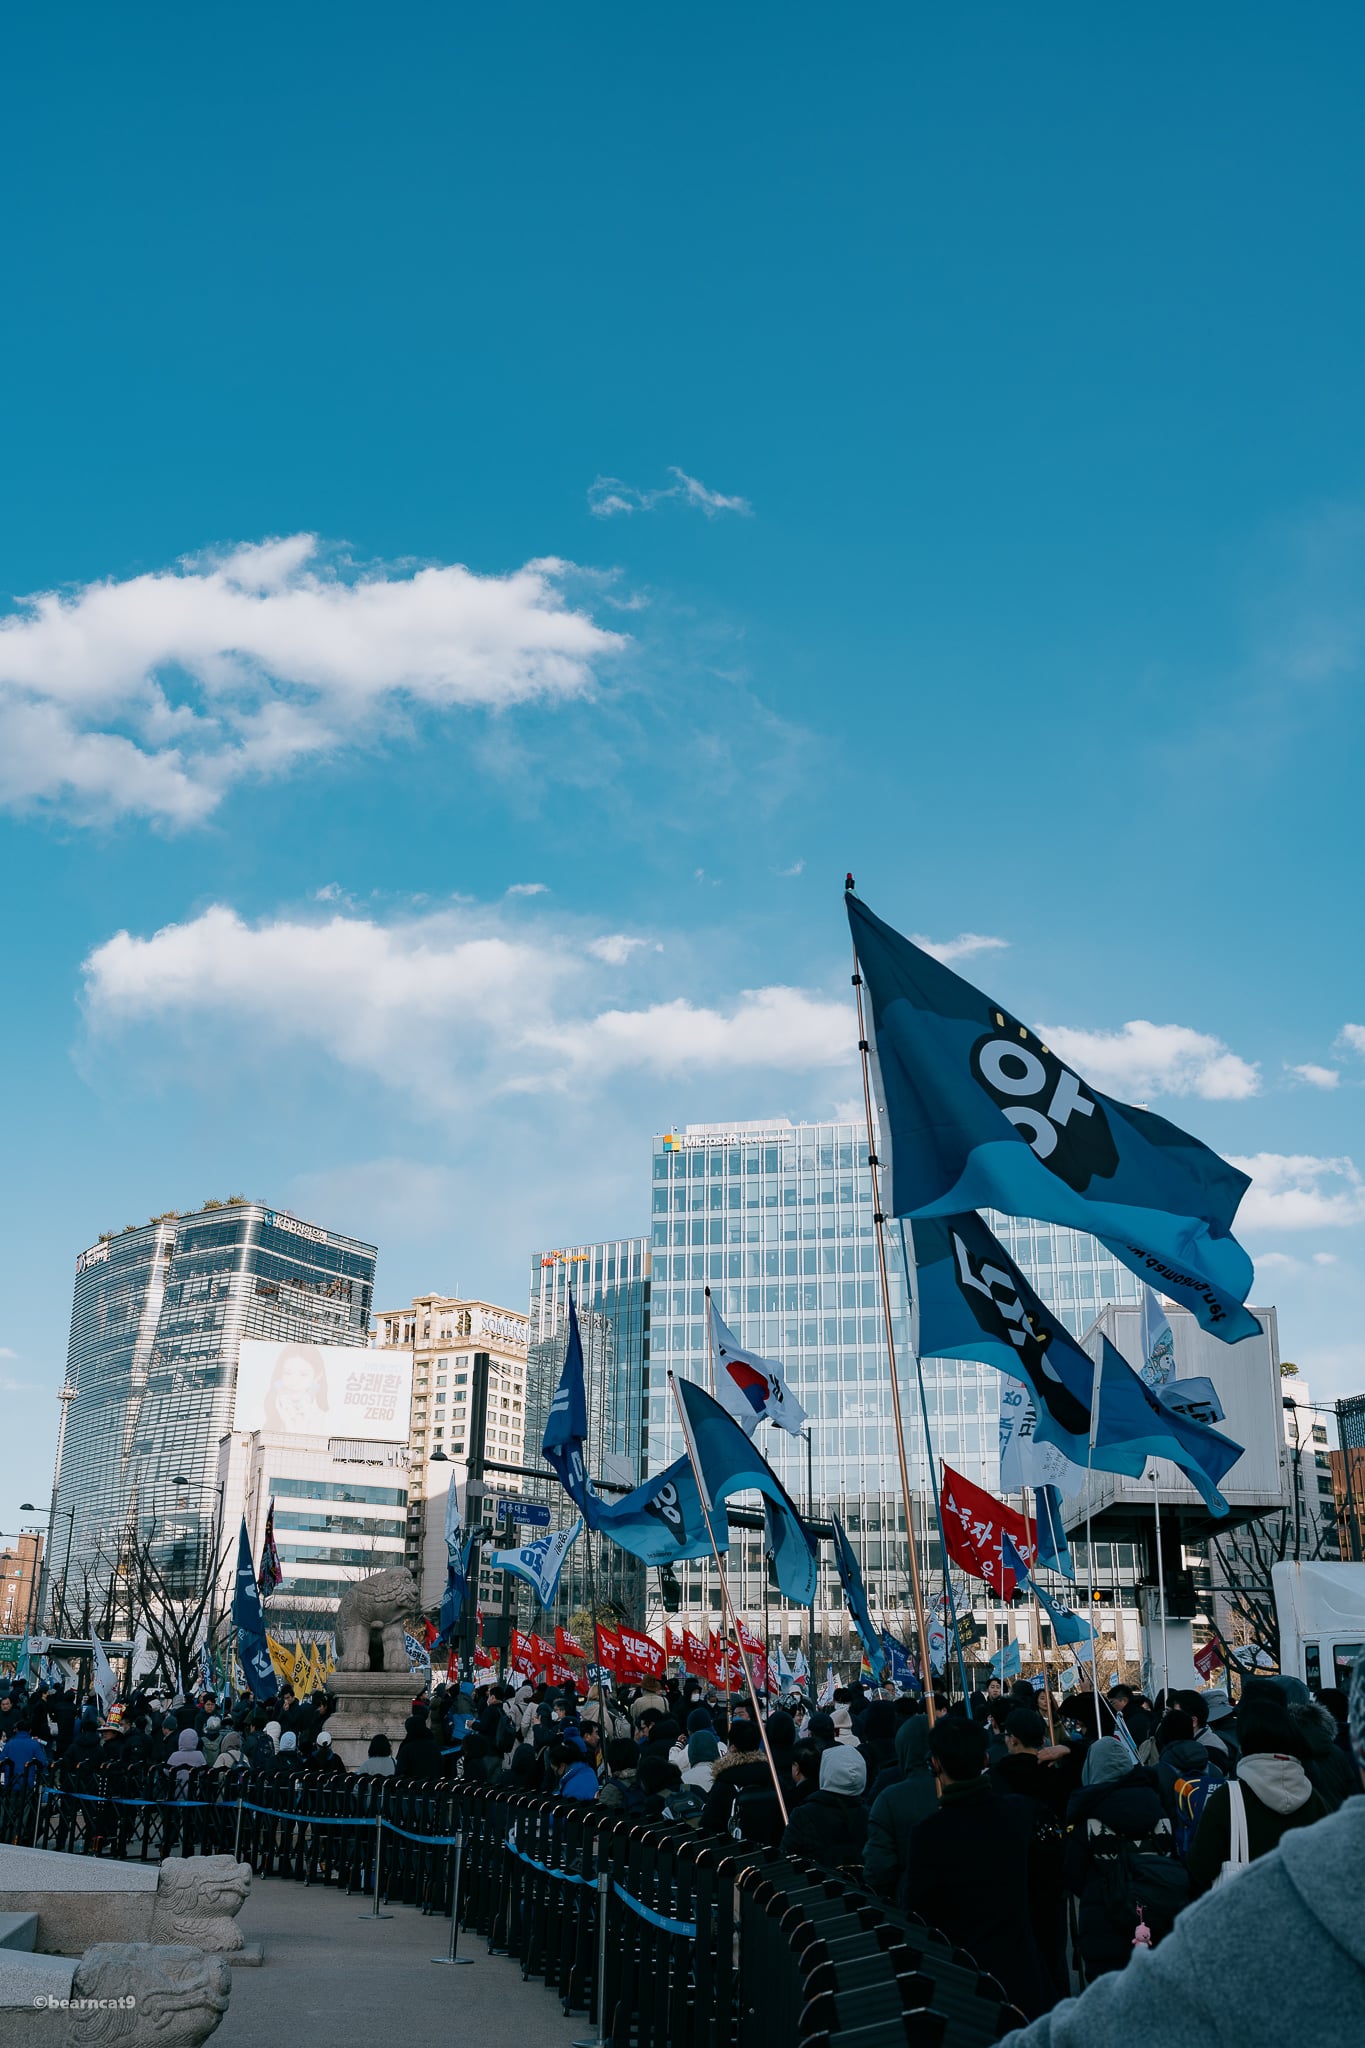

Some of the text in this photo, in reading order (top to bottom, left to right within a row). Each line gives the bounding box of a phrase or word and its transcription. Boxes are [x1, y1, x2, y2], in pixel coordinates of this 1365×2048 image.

[684, 1133, 737, 1148] Microsoft
[343, 1392, 398, 1408] BOOSTER
[363, 1407, 395, 1421] ZERO
[500, 1502, 528, 1515] 세종대로
[621, 1634, 662, 1665] 진보당
